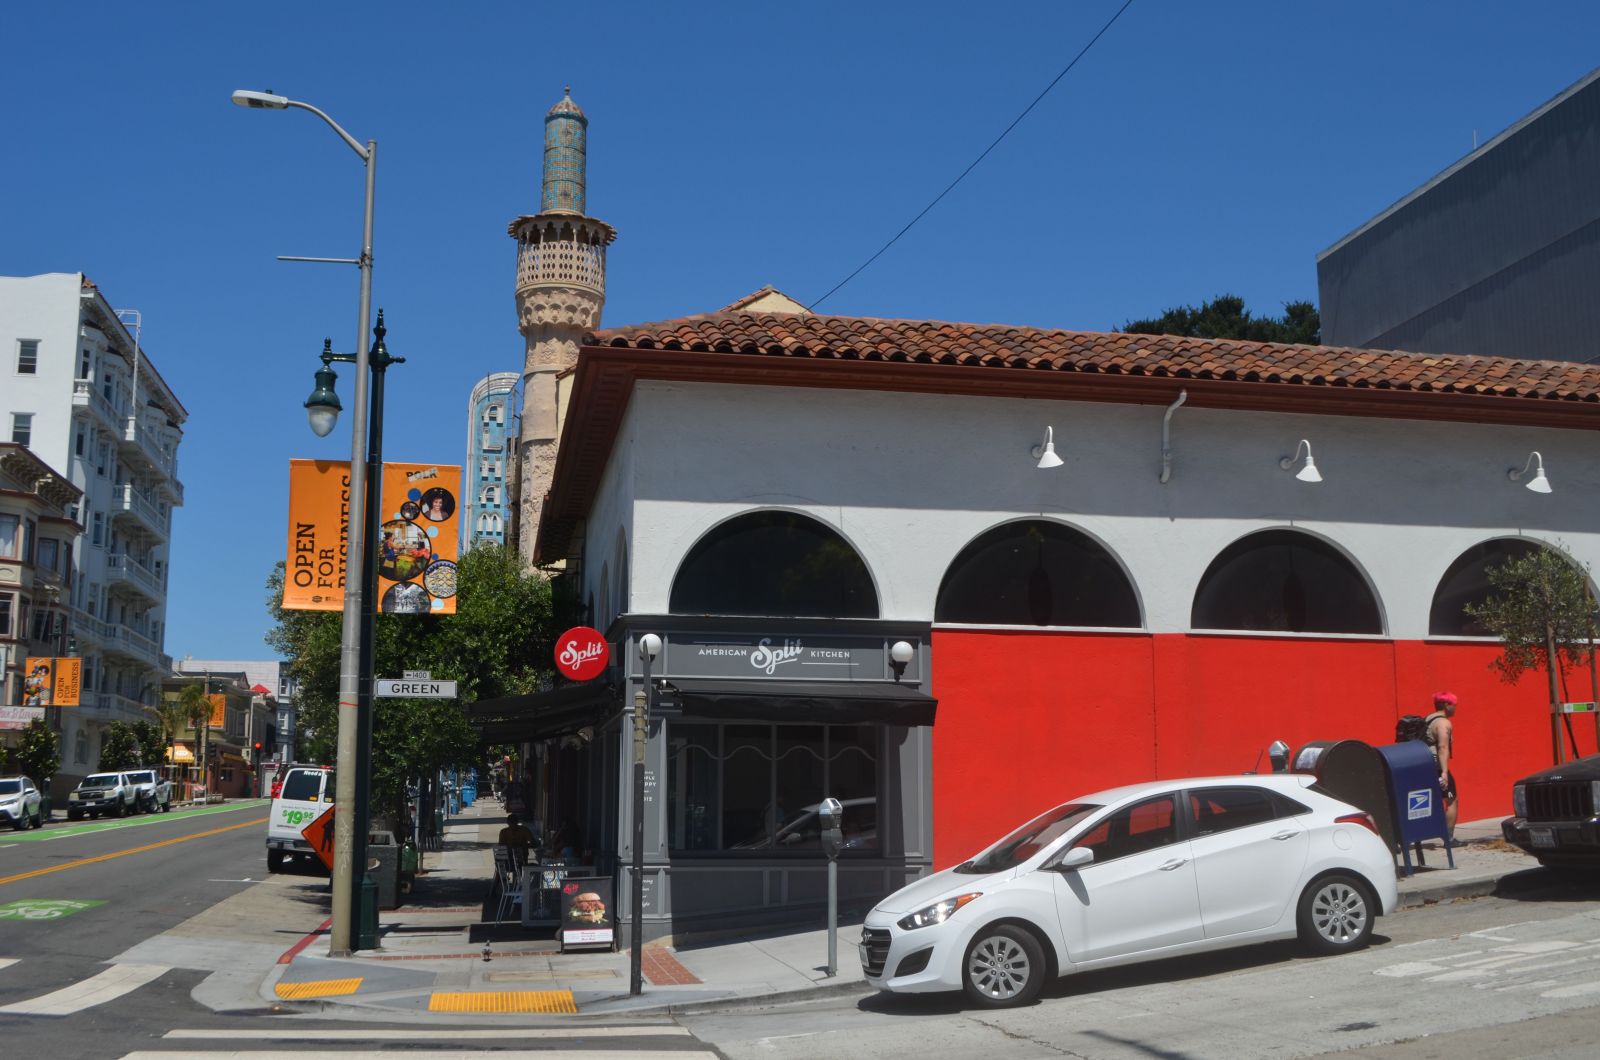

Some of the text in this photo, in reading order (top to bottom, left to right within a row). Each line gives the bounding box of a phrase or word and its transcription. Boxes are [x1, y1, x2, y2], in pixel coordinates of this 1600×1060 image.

[294, 522, 316, 588] OPEN
[317, 548, 335, 589] FOR
[559, 640, 604, 671] Split
[698, 637, 851, 675] AMERICAN Split KITCHEN
[71, 662, 79, 698] BUSINESS
[391, 683, 440, 694] GREEN
